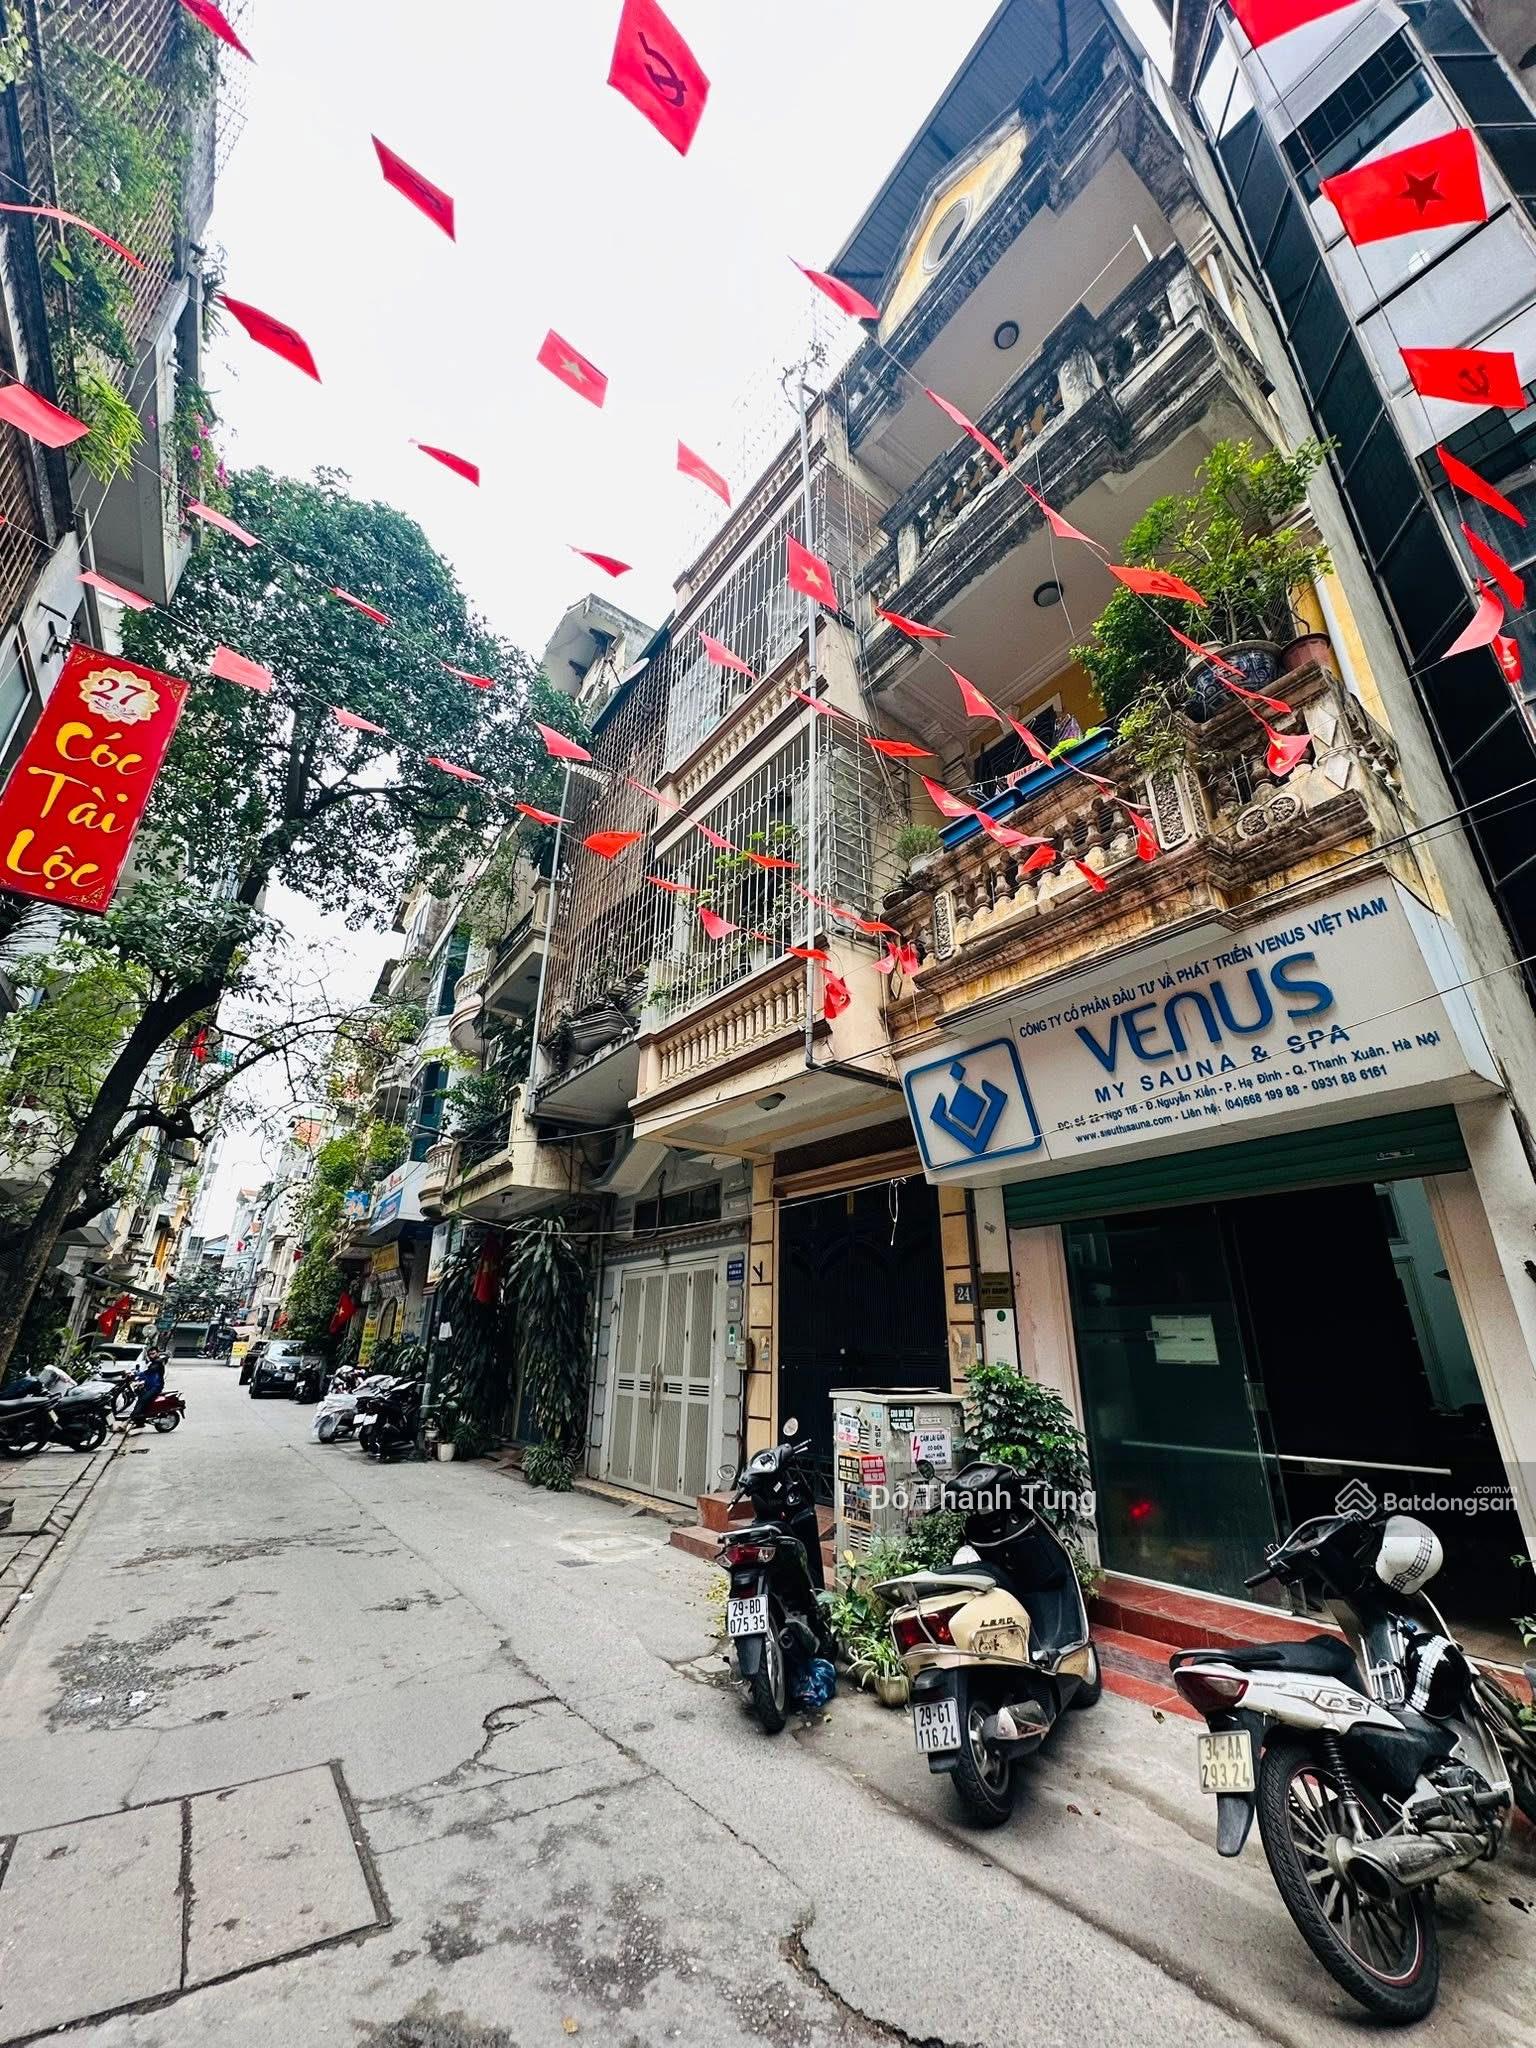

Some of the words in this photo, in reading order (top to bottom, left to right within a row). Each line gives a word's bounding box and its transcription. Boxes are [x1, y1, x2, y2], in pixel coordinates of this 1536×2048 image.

[90, 679, 146, 705] 27
[55, 721, 146, 775] Cóc
[27, 766, 129, 834] Tài
[6, 829, 103, 890] Lộc
[1020, 1018, 1047, 1038] CÔNG
[1048, 1014, 1062, 1029] TY
[1064, 1003, 1080, 1022] CỔ
[1081, 994, 1111, 1018] PHẦN
[1113, 986, 1136, 1005] ĐẦU
[1138, 981, 1155, 995] TƯ
[1158, 972, 1174, 989] VÀ
[1177, 960, 1210, 983] PHÁT
[1255, 927, 1305, 955] VENUS
[1308, 912, 1343, 936] VIỆT
[1346, 897, 1388, 923] NAM
[1075, 952, 1334, 1074] VENUS
[1095, 1082, 1125, 1104] MY
[1140, 1054, 1237, 1092] SAUNA
[1251, 1045, 1271, 1063] &
[1287, 1024, 1350, 1054] SPA
[1225, 1081, 1236, 1092] P.
[1238, 1077, 1254, 1089] Hạ
[1293, 1064, 1307, 1076] Q.
[1308, 1054, 1348, 1072] Thanh
[1392, 1038, 1412, 1052] Hà
[1180, 1107, 1202, 1120] Liên
[1265, 1087, 1283, 1101] 199
[1286, 1084, 1300, 1096] 88
[1311, 1075, 1339, 1091] 0931
[1342, 1071, 1357, 1084] 88
[1359, 1064, 1388, 1080] 6161
[957, 1287, 970, 1300] 24
[730, 1615, 765, 1634] 075.35
[919, 1725, 957, 1749] 116.24
[920, 1703, 951, 1727] 29-G1
[1202, 1762, 1250, 1788] 293.24
